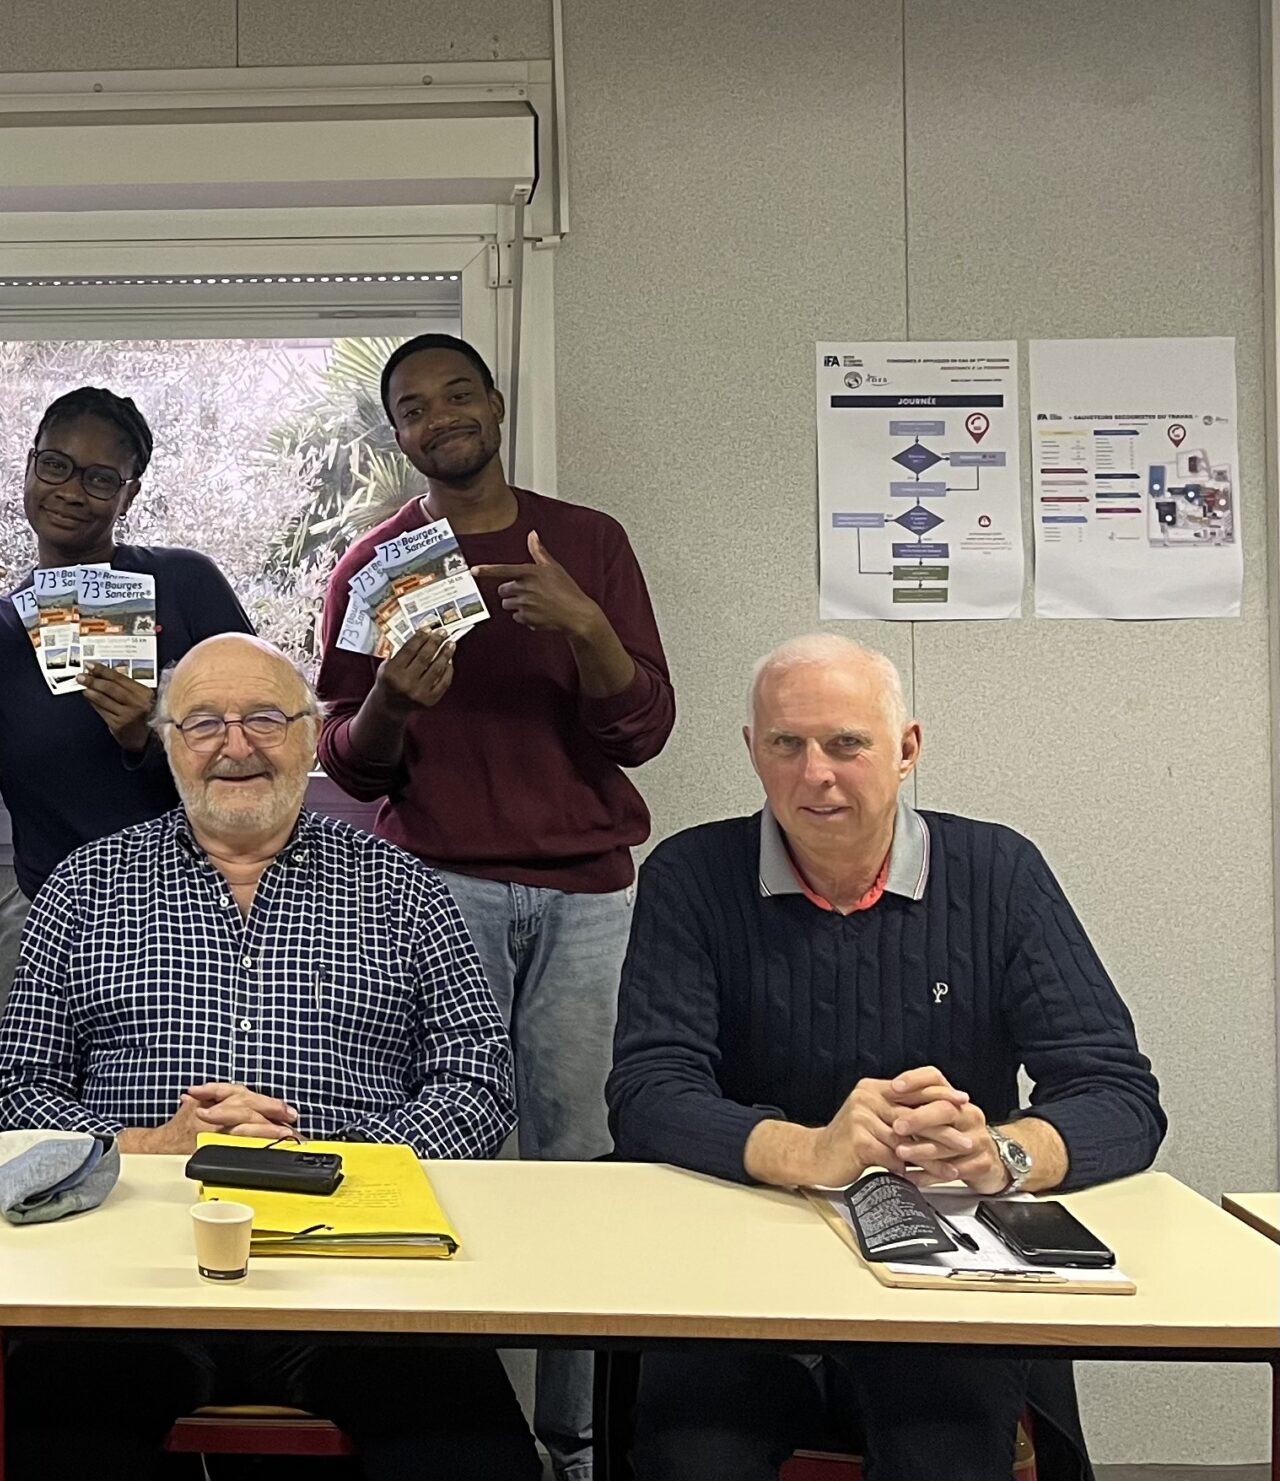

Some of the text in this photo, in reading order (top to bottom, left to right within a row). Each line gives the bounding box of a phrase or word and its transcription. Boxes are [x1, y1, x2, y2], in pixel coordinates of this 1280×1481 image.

[897, 396, 937, 406] JOURNÉE
[401, 525, 438, 546] Bourges
[104, 581, 143, 591] Bourges
